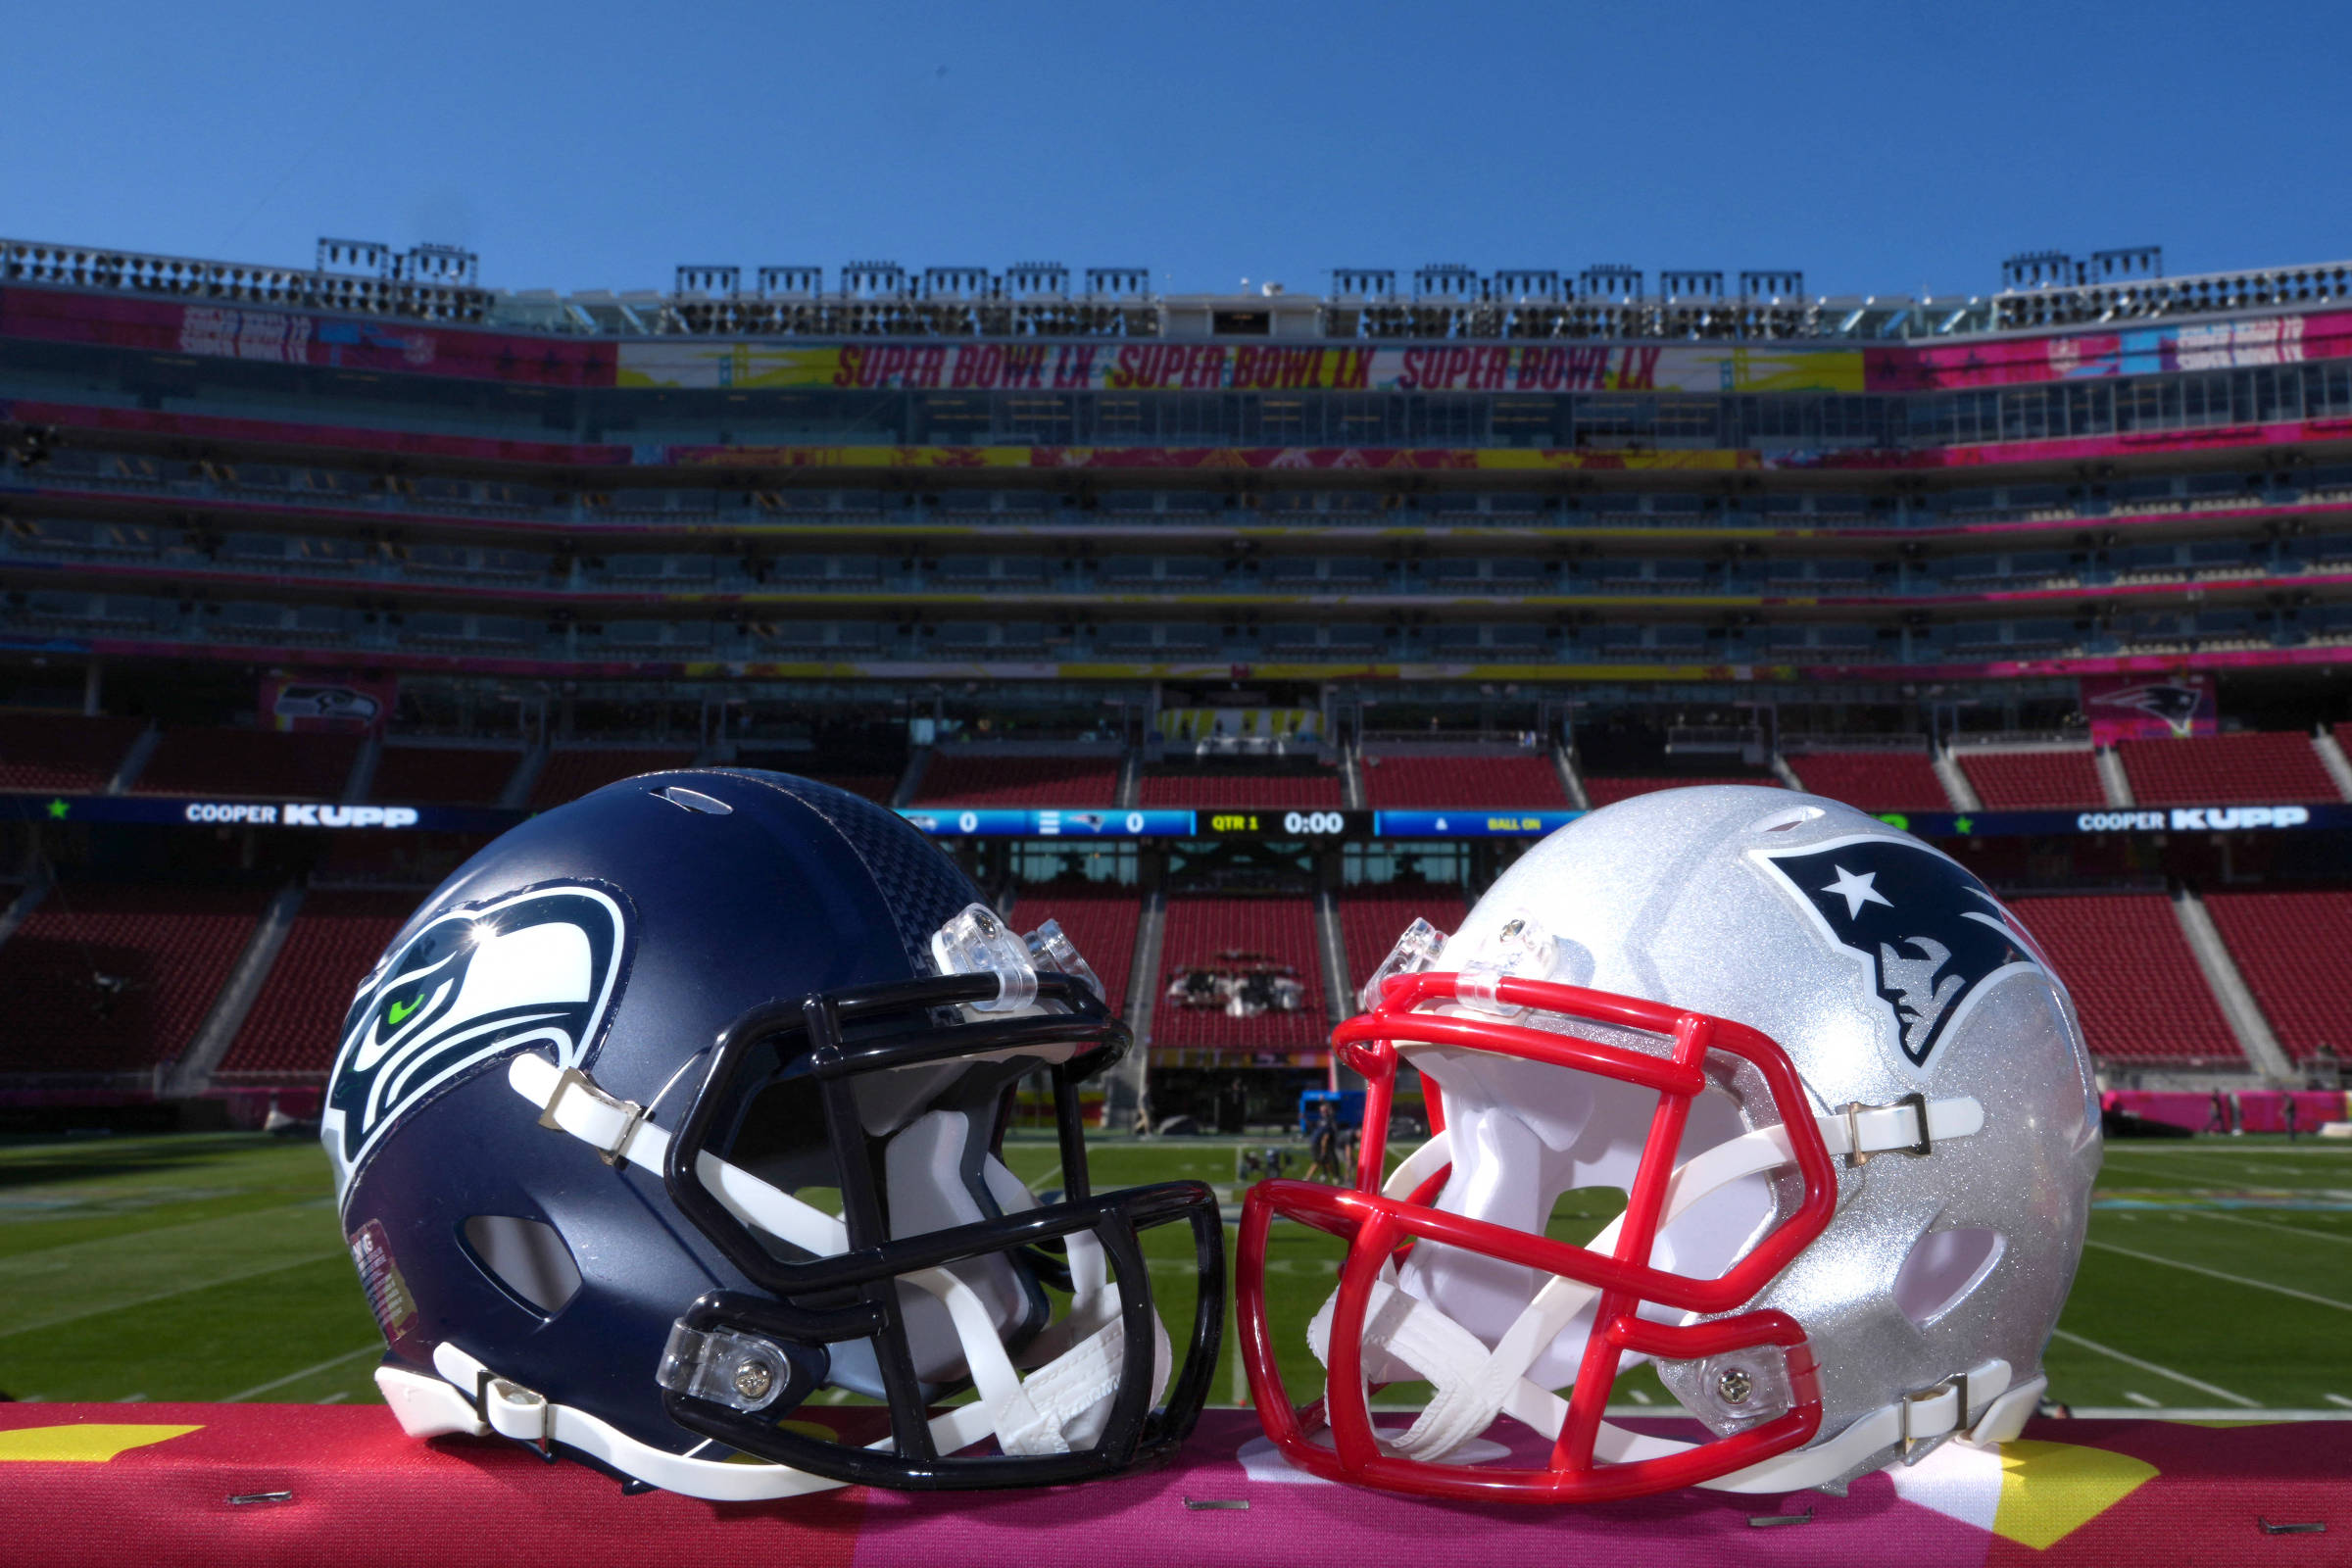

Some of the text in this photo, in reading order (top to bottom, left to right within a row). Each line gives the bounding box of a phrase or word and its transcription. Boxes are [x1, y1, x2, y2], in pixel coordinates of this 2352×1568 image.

[834, 345, 1099, 388] SUPER BOWL LX
[1113, 345, 1376, 388] SUPER BOWL LX
[1398, 346, 1661, 389] SUPER BOWL LX
[185, 804, 418, 827] COOPER KUPP
[958, 811, 978, 833] 0
[1126, 811, 1145, 833] 0
[1211, 815, 1259, 831] QTR 1
[1284, 811, 1344, 834] 0:00
[1488, 817, 1542, 831] BALL ON
[2078, 806, 2309, 831] COOPER KUPP
